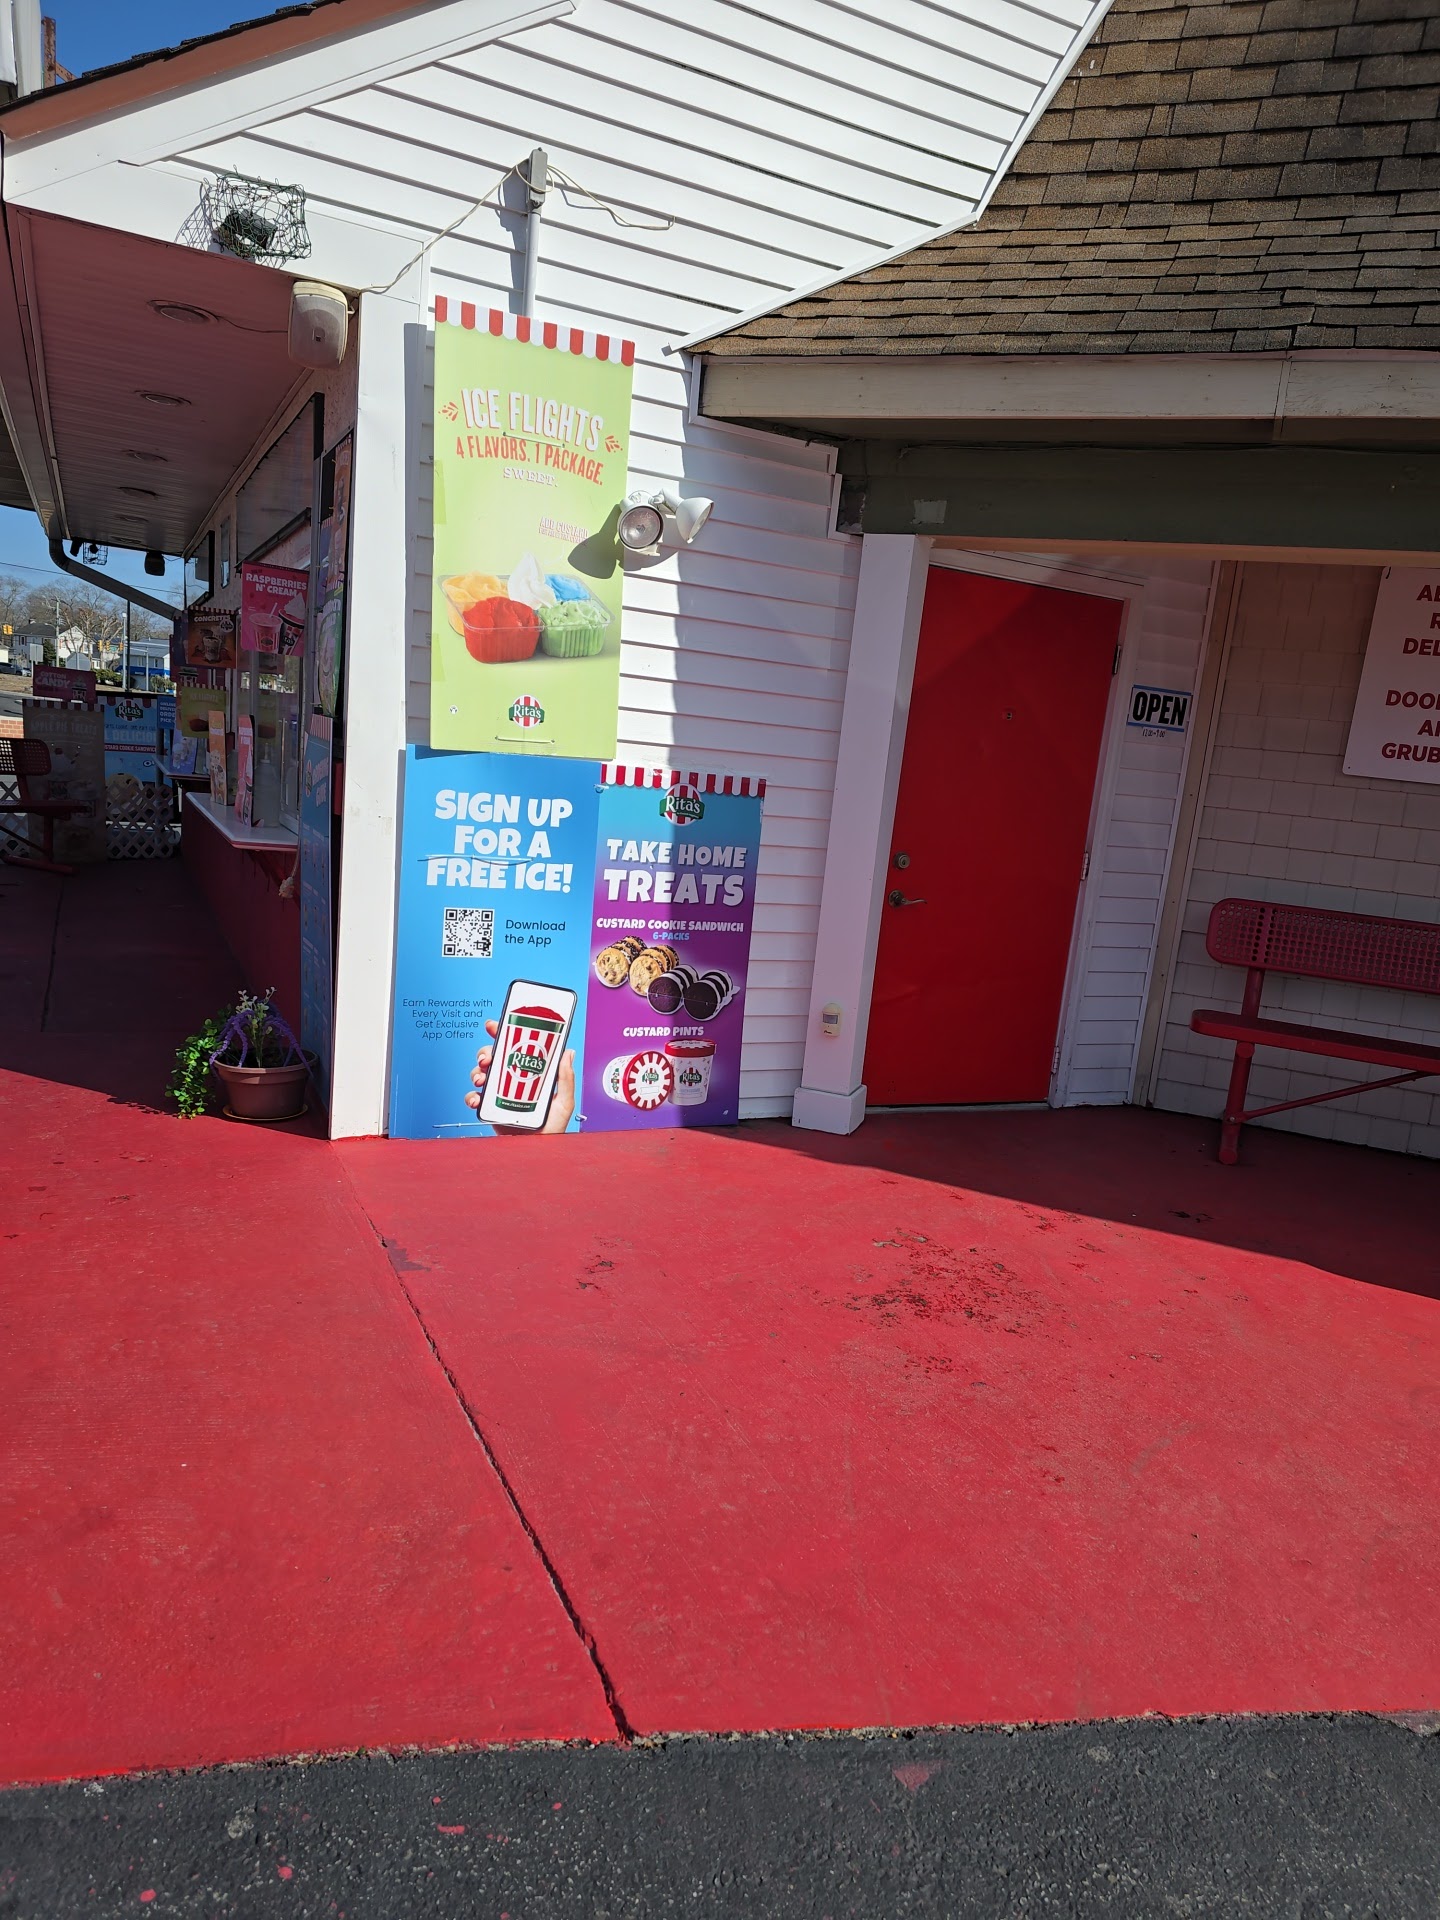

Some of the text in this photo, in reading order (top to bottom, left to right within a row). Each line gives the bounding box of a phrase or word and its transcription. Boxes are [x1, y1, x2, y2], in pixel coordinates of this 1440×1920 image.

[461, 387, 604, 452] ICE FLIGHTS
[456, 435, 604, 486] 4 FLAVORS. 1 PACKAGE.
[503, 466, 559, 487] SWEET.
[540, 516, 555, 531] ADD
[246, 573, 307, 591] RASPBERRIES
[267, 585, 298, 597] CREAM
[35, 677, 70, 690] CANDY
[40, 671, 67, 681] COTTON
[1385, 690, 1440, 711] DOO
[118, 705, 141, 716] Rita's
[513, 704, 541, 719] Rita's
[1133, 692, 1188, 726] OPEN
[435, 789, 573, 828] SIGN UP
[665, 795, 701, 815] Rita's
[454, 825, 552, 858] FOR A
[607, 838, 747, 868] TAKE HOME
[426, 857, 574, 894] FREE ICE!
[603, 869, 744, 907] TREATS
[505, 919, 566, 931] Download
[596, 917, 744, 932] CUSTARD COOKIE SANDWICH
[504, 934, 552, 948] the App
[653, 932, 690, 941] 6-PACKS
[403, 999, 493, 1007] Earn Rewards with
[412, 1009, 483, 1019] Every Visit and
[415, 1020, 479, 1029] Get Exclusive
[623, 1026, 704, 1037] CUSTARD PINTS
[422, 1031, 474, 1041] App Offers
[511, 1051, 543, 1071] Rita's
[682, 1072, 702, 1082] Rita's
